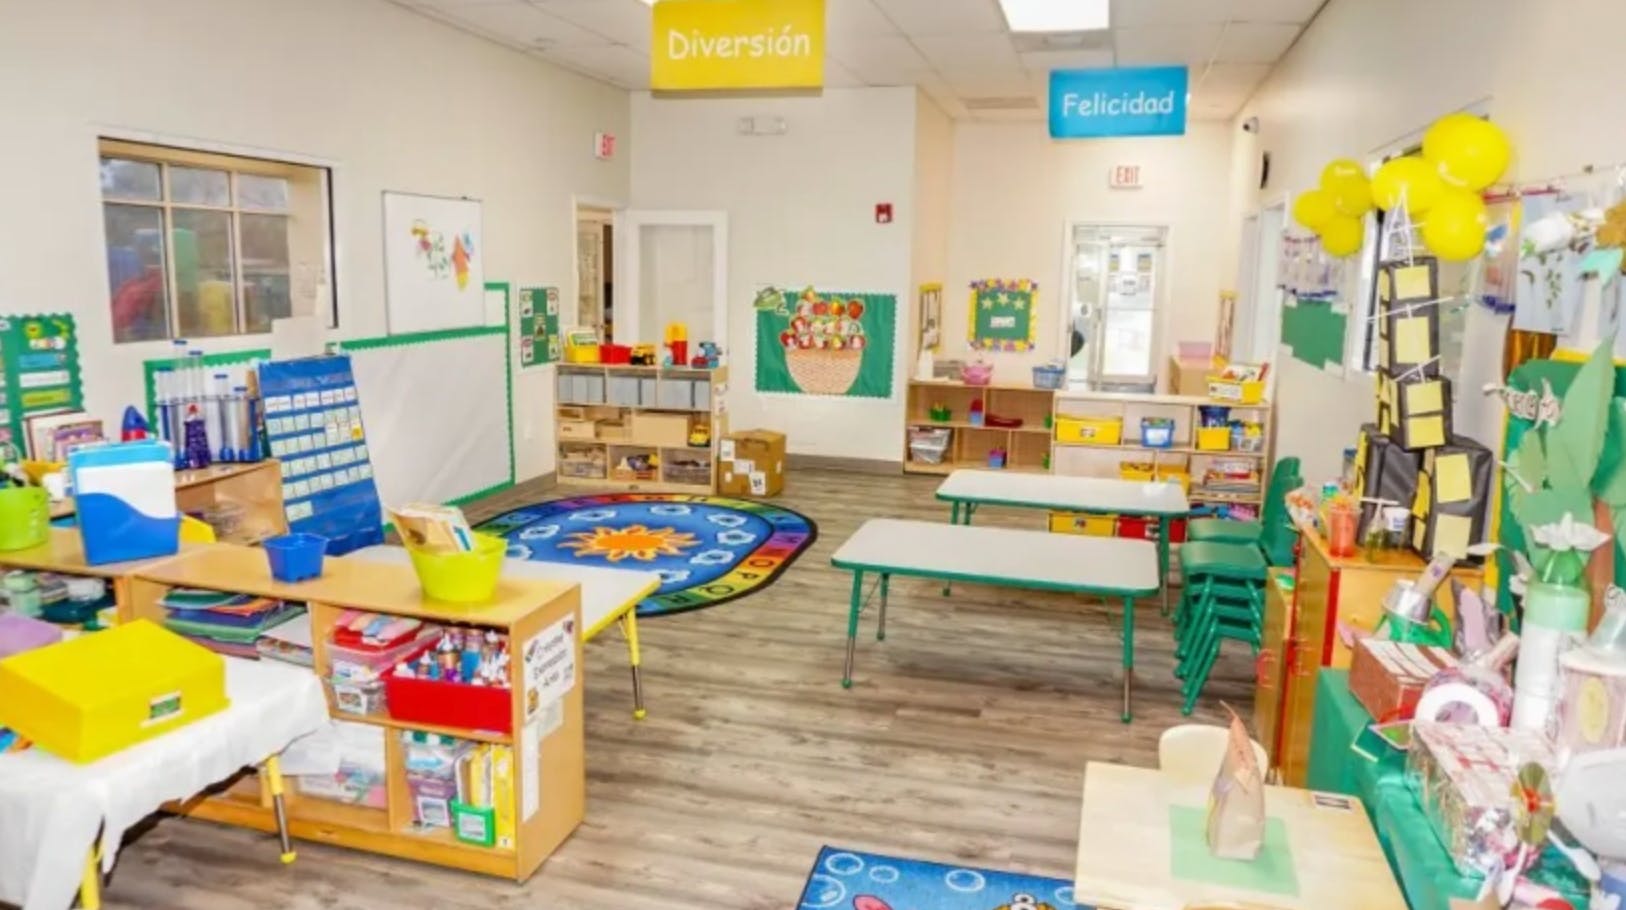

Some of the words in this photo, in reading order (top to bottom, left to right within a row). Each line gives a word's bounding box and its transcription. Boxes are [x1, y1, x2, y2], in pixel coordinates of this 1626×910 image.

[668, 23, 810, 60] Diversión
[1063, 90, 1175, 117] Felicidad
[1116, 165, 1141, 185] EXIT
